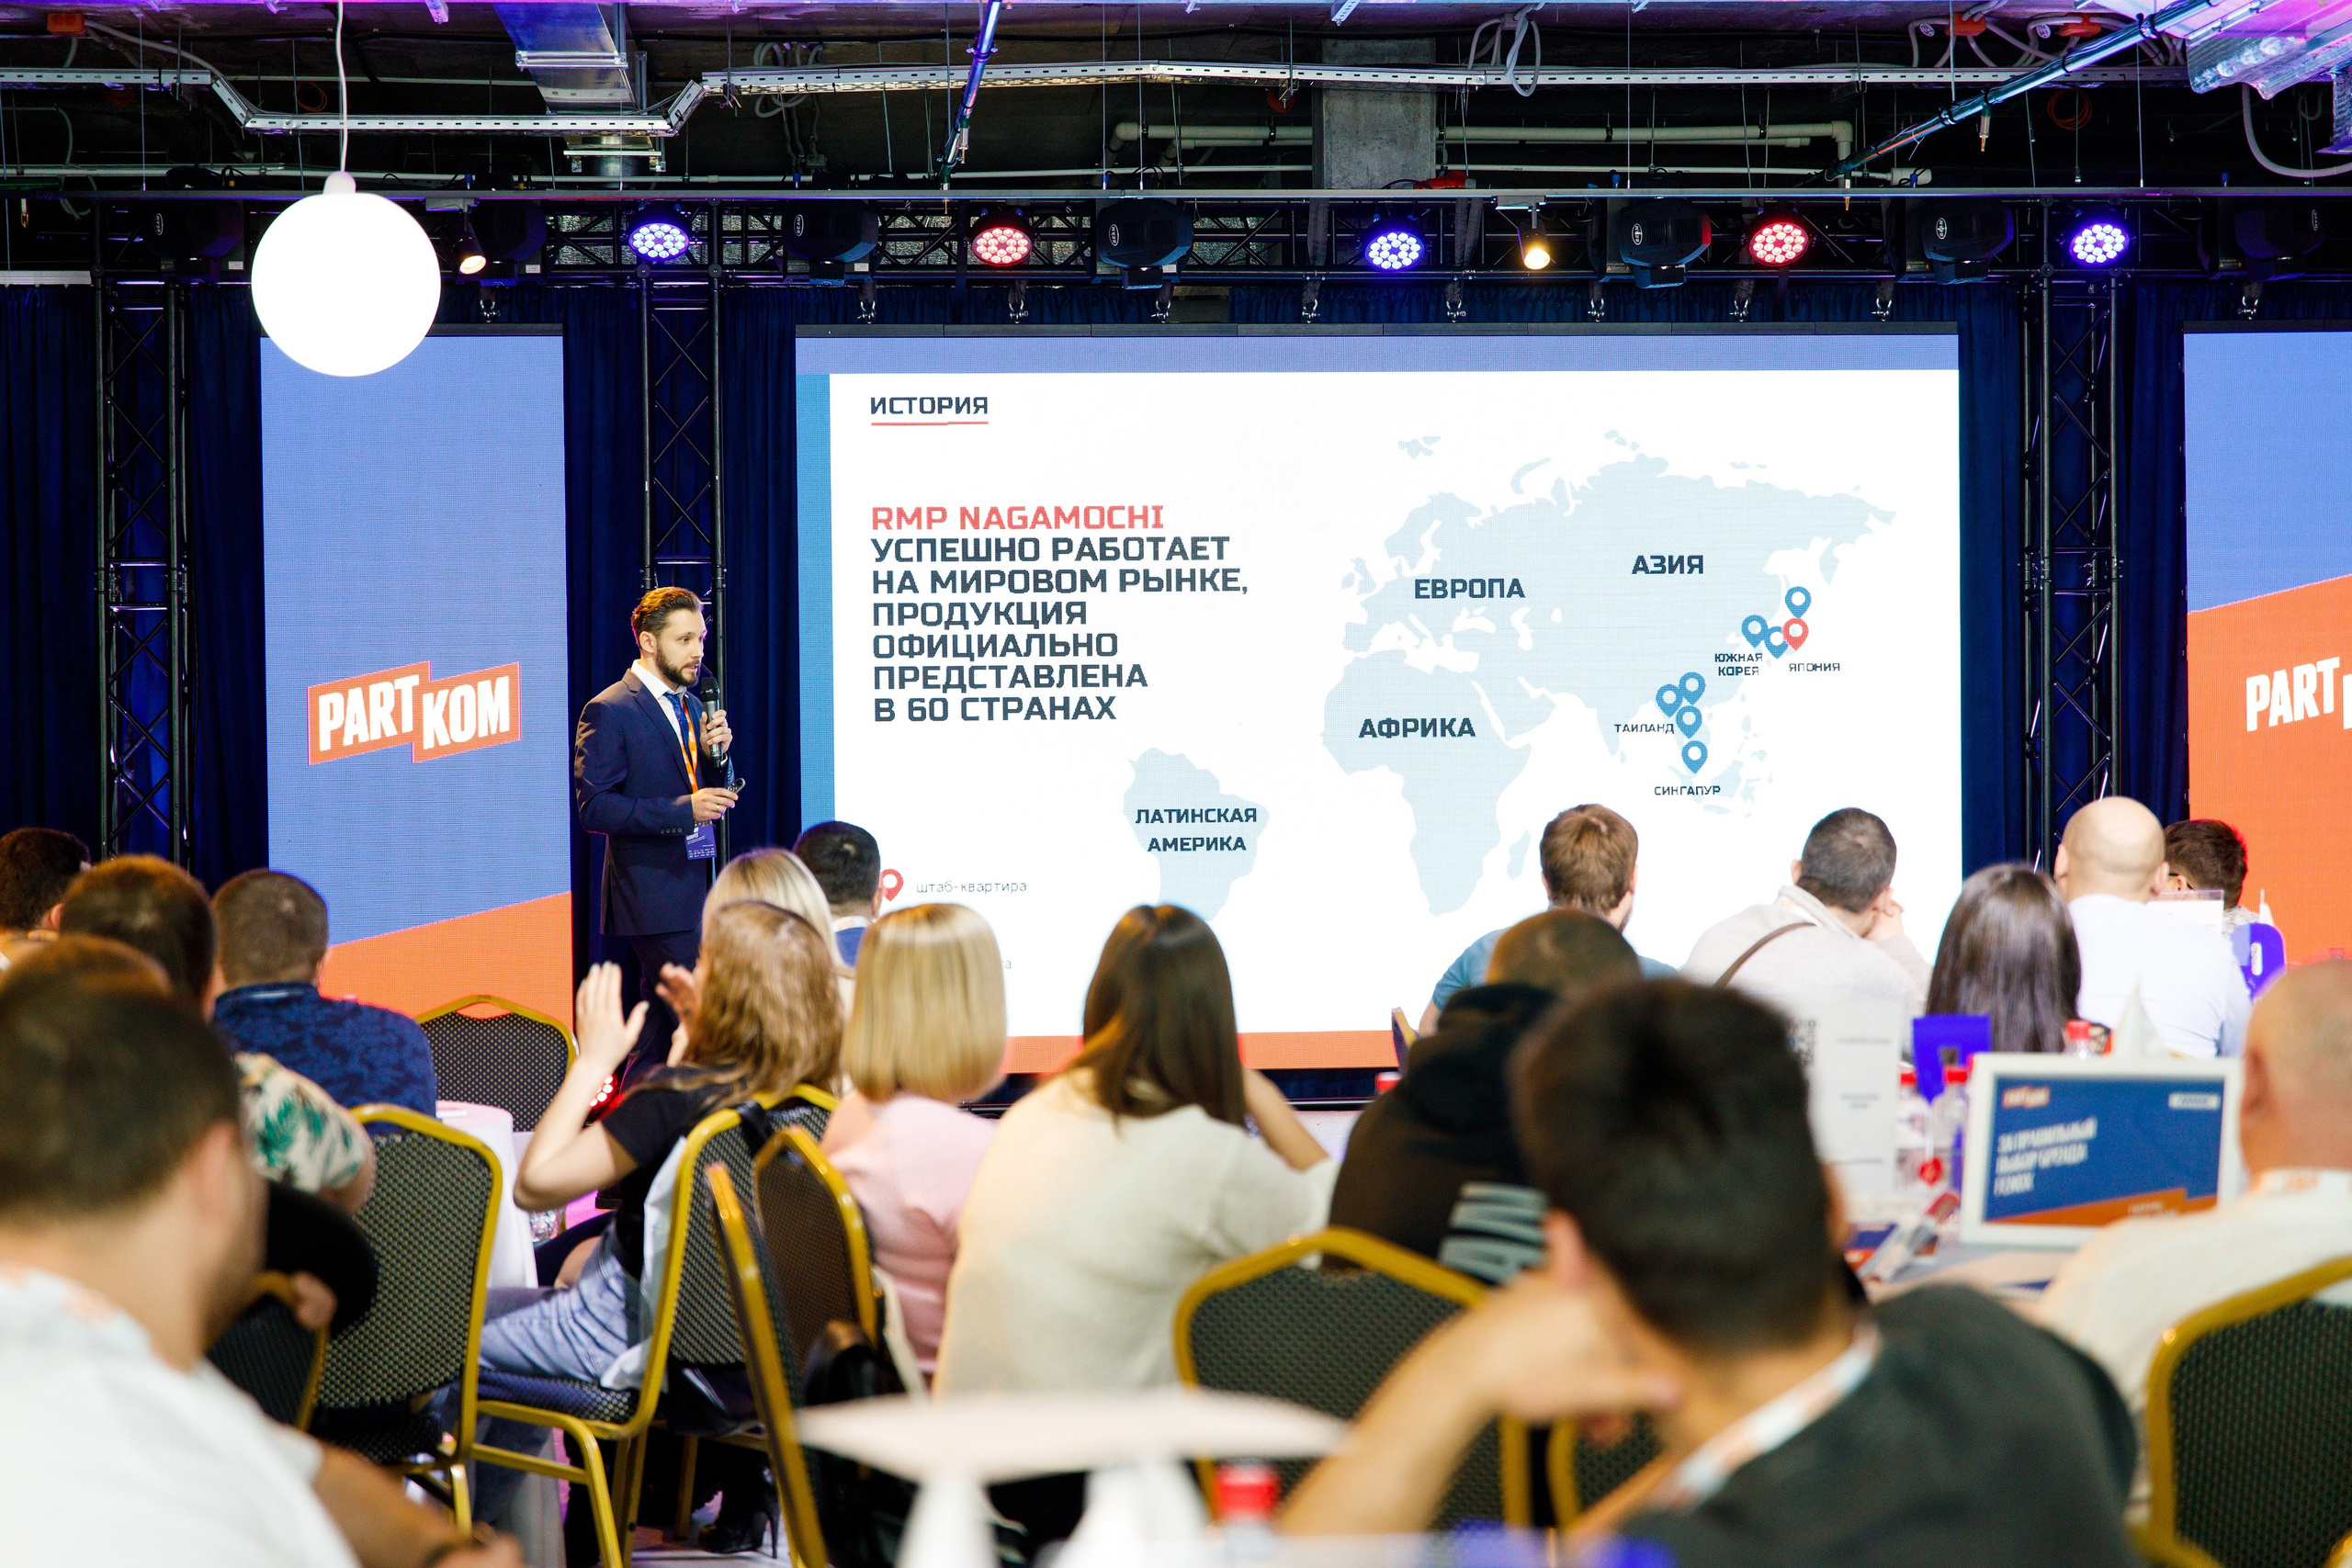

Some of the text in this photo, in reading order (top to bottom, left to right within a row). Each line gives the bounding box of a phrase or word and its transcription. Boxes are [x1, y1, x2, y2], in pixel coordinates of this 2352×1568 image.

[870, 396, 989, 415] ИСТОРИЯ
[872, 505, 1164, 531] RMP NAGAMOCHI
[870, 536, 1230, 563] УСПЕШНО РАБОТАЕТ
[1631, 555, 1704, 575] АЗИЯ
[872, 568, 1248, 595] НА МИРОВОМ РЫНКЕ,
[1414, 578, 1526, 600] ЕВРОПА
[873, 601, 1088, 631] ПРОДУКЦИЯ
[873, 632, 1119, 663] ОФИЦИАЛЬНО
[1714, 653, 1763, 663] ЮЖНАЯ
[1718, 666, 1759, 677] КОРЕЯ
[1789, 662, 1840, 672] ЯПОНИЯ
[874, 663, 1149, 694] ПРЕДСТАВЛЕНА
[2245, 656, 2340, 732] PART
[319, 673, 510, 751] PART KOM
[874, 695, 1117, 722] В 60 СТРАНАХ
[1358, 717, 1476, 739] АФРИКА
[1654, 785, 1721, 795] СИНГАПУР
[1135, 807, 1257, 824] ЛАТИНСКАЯ
[1148, 835, 1247, 852] АМЕРИКА
[916, 880, 1027, 895] штаб-квартира
